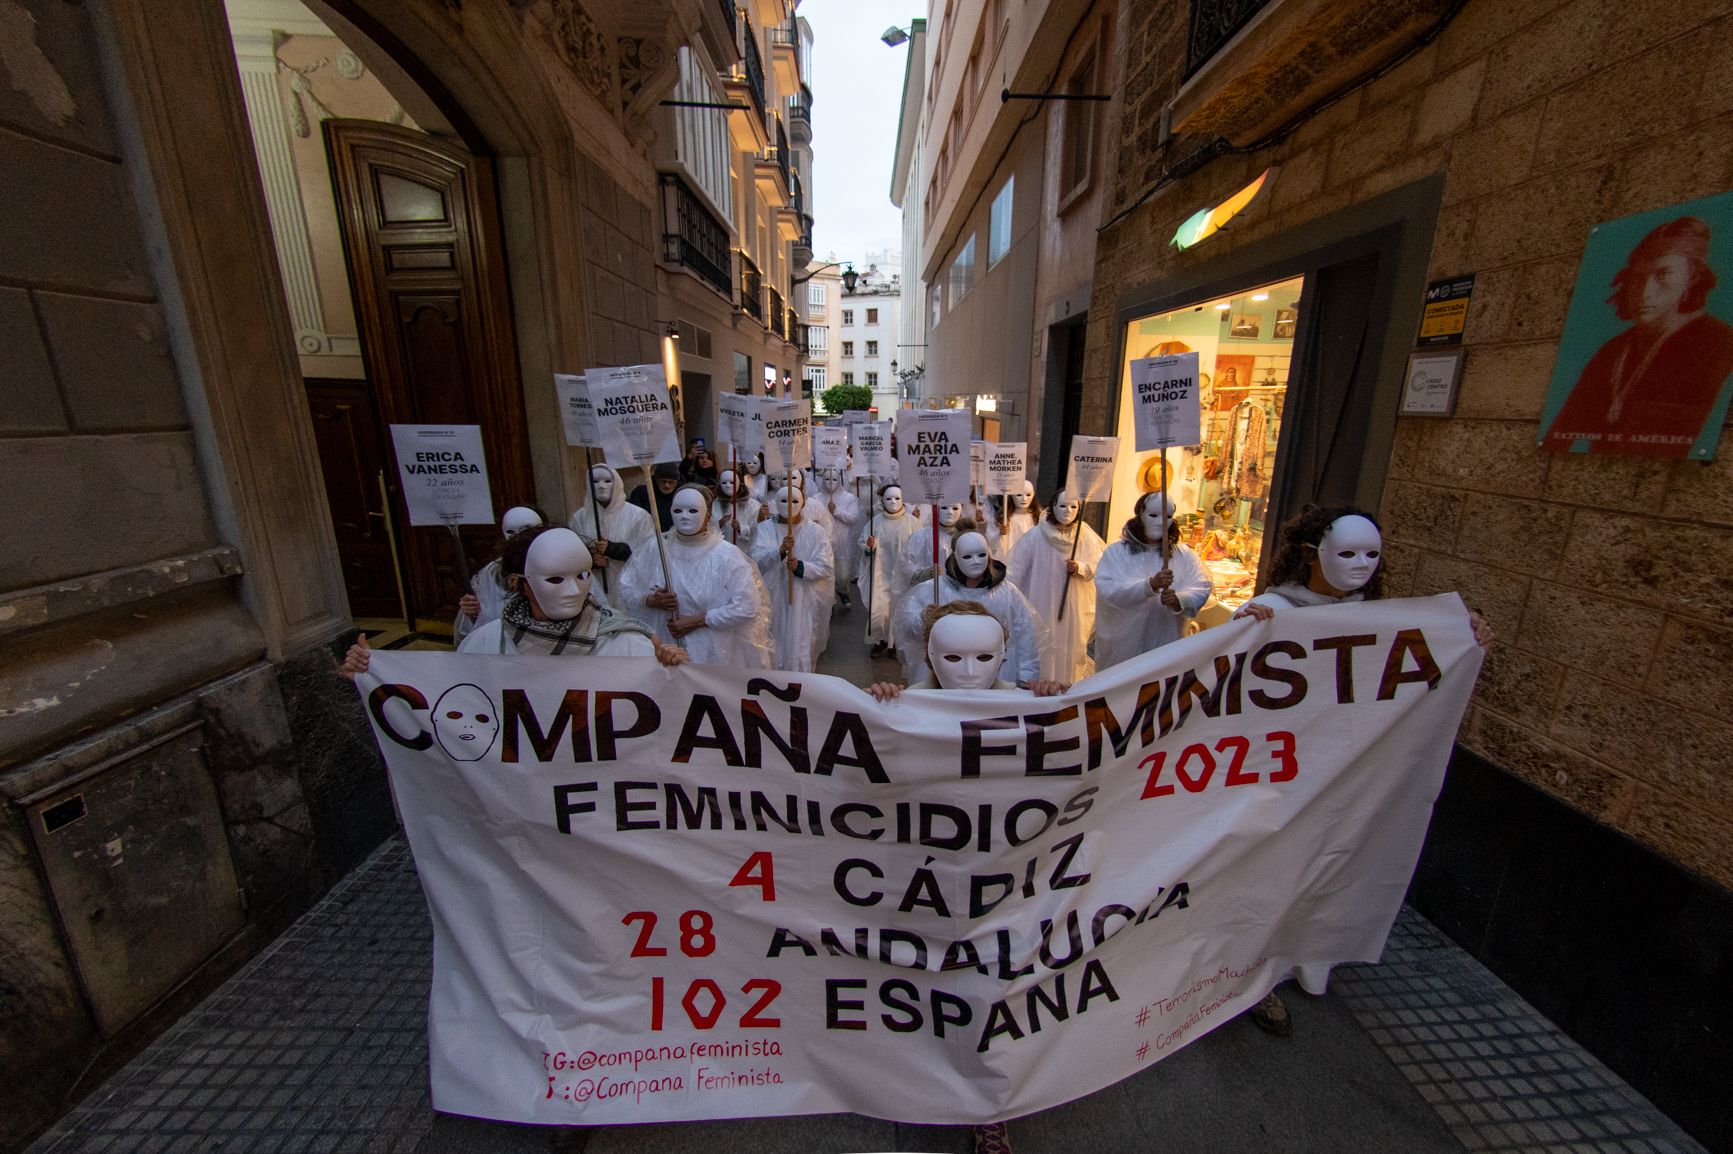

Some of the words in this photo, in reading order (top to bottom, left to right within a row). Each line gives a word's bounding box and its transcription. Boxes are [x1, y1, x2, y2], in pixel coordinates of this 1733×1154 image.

[1138, 377, 1193, 394] ENCARNI
[604, 393, 658, 407] NATALIA
[1142, 389, 1189, 404] MUÑOZ
[597, 402, 668, 417] MOSQUERA
[719, 408, 745, 418] VIOLETA
[766, 417, 808, 429] CARMEN
[917, 431, 949, 443] EVA
[415, 452, 464, 462] ERICA
[917, 455, 951, 467] AZA
[1073, 455, 1113, 463] CATERINA
[405, 464, 480, 475] VANESSA
[425, 478, 438, 487] 22
[440, 477, 465, 487] años
[960, 627, 1443, 779] FEMINISTA
[1136, 731, 1299, 800] 2023
[553, 781, 1099, 854] FEMINICIDIOS
[728, 851, 777, 902] 4
[621, 909, 717, 958] 28
[651, 976, 782, 1031] 102
